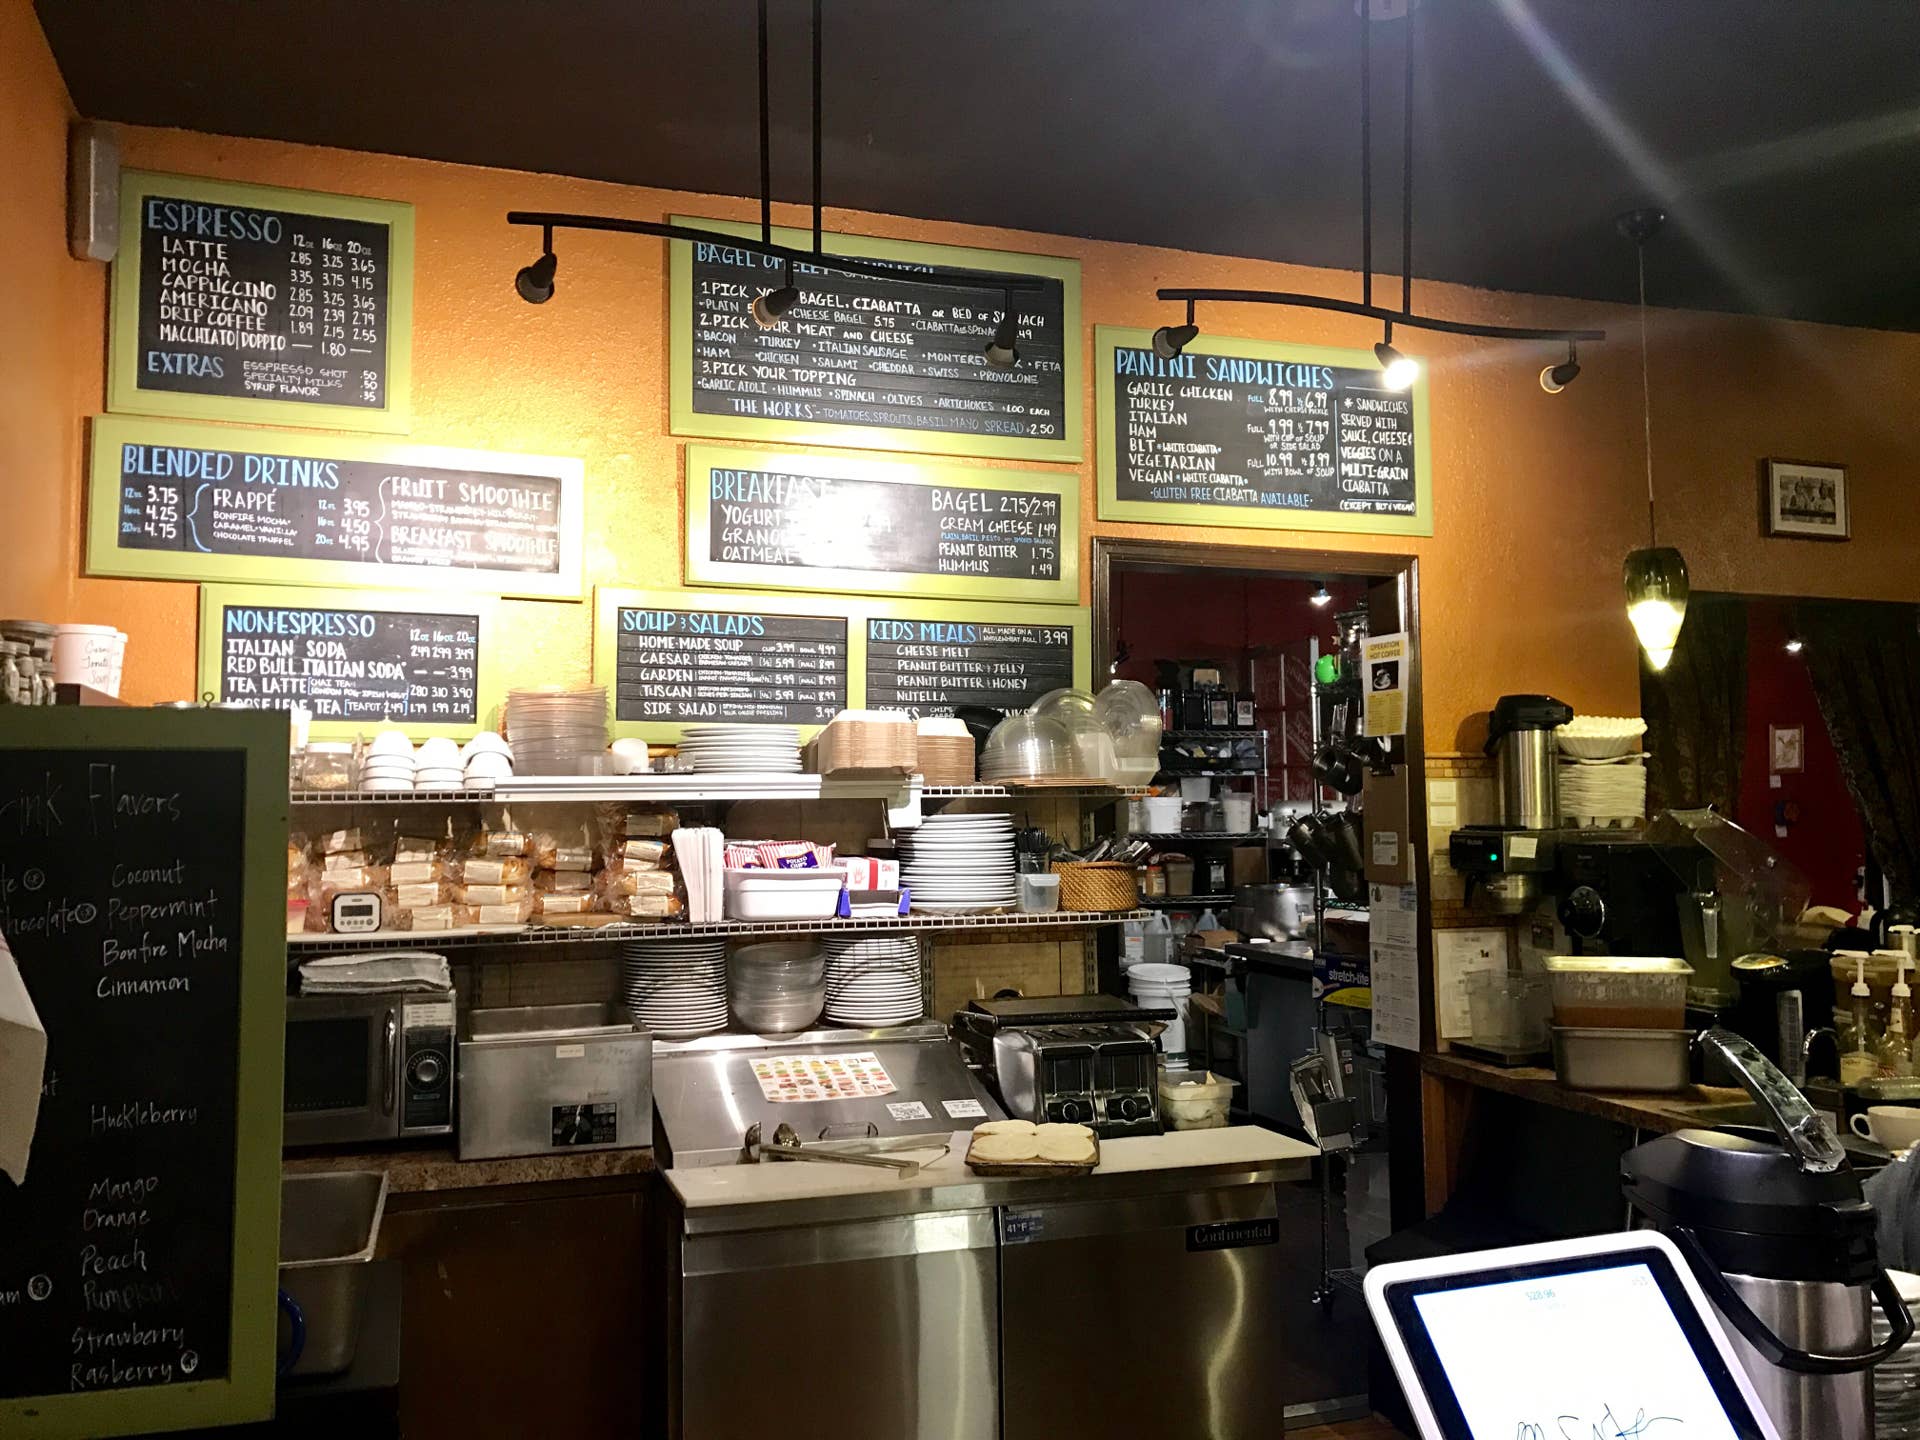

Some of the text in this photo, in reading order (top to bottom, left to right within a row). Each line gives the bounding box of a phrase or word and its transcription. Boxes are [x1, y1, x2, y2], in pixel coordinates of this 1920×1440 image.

[149, 200, 282, 244] ESPRESSO
[162, 236, 375, 273] LATTE 2.85 3.25 3.65
[162, 257, 373, 290] MOCHA 3.35 3.75 4.15
[161, 273, 375, 311] CAPPUCCINO 2.85 3.25 3.65
[160, 289, 374, 326] AMERICANO 2.09 2.79
[706, 299, 866, 325] PLAIN CHEESE BAGEL
[852, 297, 972, 320] CIABATTA BED
[160, 306, 376, 343] DRIP COFFEE 2.55
[797, 324, 914, 346] MEAT CHEESE
[703, 332, 1061, 372] BACON TURKEY ITALIAN FETA
[147, 351, 224, 378] EXTRAS
[320, 368, 348, 379] SHOT
[703, 347, 1039, 384] HAM CHICKEN SALAMI CHEDDAR SWISS PROVOLONE
[1117, 349, 1333, 390] PANINI SANDWICHES
[752, 366, 857, 386] YOUR TOPPING
[244, 380, 320, 396] SYRUP FLAVOR
[701, 378, 735, 392] GARLIC
[738, 380, 767, 394] AIOLI
[777, 385, 822, 397] HUMMUS
[834, 390, 875, 402] SPINACH
[887, 394, 923, 406] OLIVES
[938, 400, 994, 412] ARTICHOKES
[1127, 381, 1327, 408] GARLIC CHICKEN 8.99 6.99
[1129, 398, 1174, 412] TURKEY
[1357, 398, 1408, 415] SANDWICHES
[985, 419, 1024, 433] SPREAD
[1129, 411, 1188, 426] ITALIAN
[1341, 413, 1397, 429] SERVED WITH
[1129, 424, 1156, 438] HAM
[1129, 438, 1156, 452] BLT
[1341, 446, 1393, 462] VEGGIES ON
[123, 445, 339, 490] BLENDED DRINKS
[1129, 452, 1292, 471] VEGETARIAN 10.99
[1129, 469, 1208, 484] VEGAN WHITE
[1342, 479, 1390, 496] CIABATTA
[147, 485, 178, 504] 3.75
[343, 498, 370, 518] 3.95
[391, 476, 448, 499] FRUIT
[459, 482, 553, 512] SMOOTHIE
[711, 469, 1056, 518] BREAKFAST BAGEL 2.75/2.99
[1153, 487, 1309, 507] GLUTEN FREE CIABATTA AVAILABLE
[146, 506, 370, 536] 4.25 4.50
[721, 504, 782, 526] YOGURT
[144, 523, 177, 539] 4.75
[390, 525, 473, 550] BREAKFAST
[940, 517, 1033, 536] CREAM CHEESE
[722, 545, 1052, 576] OATMEAL HUMMUS 1.49
[938, 542, 1054, 560] PEANUT BUTTER 1.75
[623, 610, 765, 636] SOUP SALADS
[869, 620, 1068, 646] KIDS MEALS 3.99
[982, 627, 996, 635] ALL
[226, 639, 347, 660] ITALIAN SODA
[714, 638, 743, 651] SOUP
[896, 645, 971, 658] CHEESE MELT
[227, 656, 365, 678] RED BULL ITALIAN
[639, 653, 693, 667] CAESAR
[897, 659, 1025, 675] PEANUT BUTTER JELLY
[227, 676, 307, 694] TEA LATTE
[640, 668, 693, 682] GARDEN
[897, 675, 1027, 690] PEANUT BUTTER HONEY
[642, 684, 692, 698] TUSCAN
[896, 691, 948, 703] NUTELLA
[315, 699, 341, 715] TEA
[643, 702, 673, 715] SIDE
[678, 702, 717, 716] SALAD
[88, 763, 183, 837] Flavors
[111, 858, 185, 888] Coconut
[108, 889, 218, 931] Peppermint
[102, 925, 228, 967] Bonfire Mocha
[96, 975, 190, 999] Cinnamon
[90, 1101, 199, 1134] Huckleberry
[88, 1176, 159, 1205] Mango
[83, 1207, 151, 1232] Orange
[80, 1238, 148, 1277] Peach
[71, 1322, 185, 1355] Strawberry
